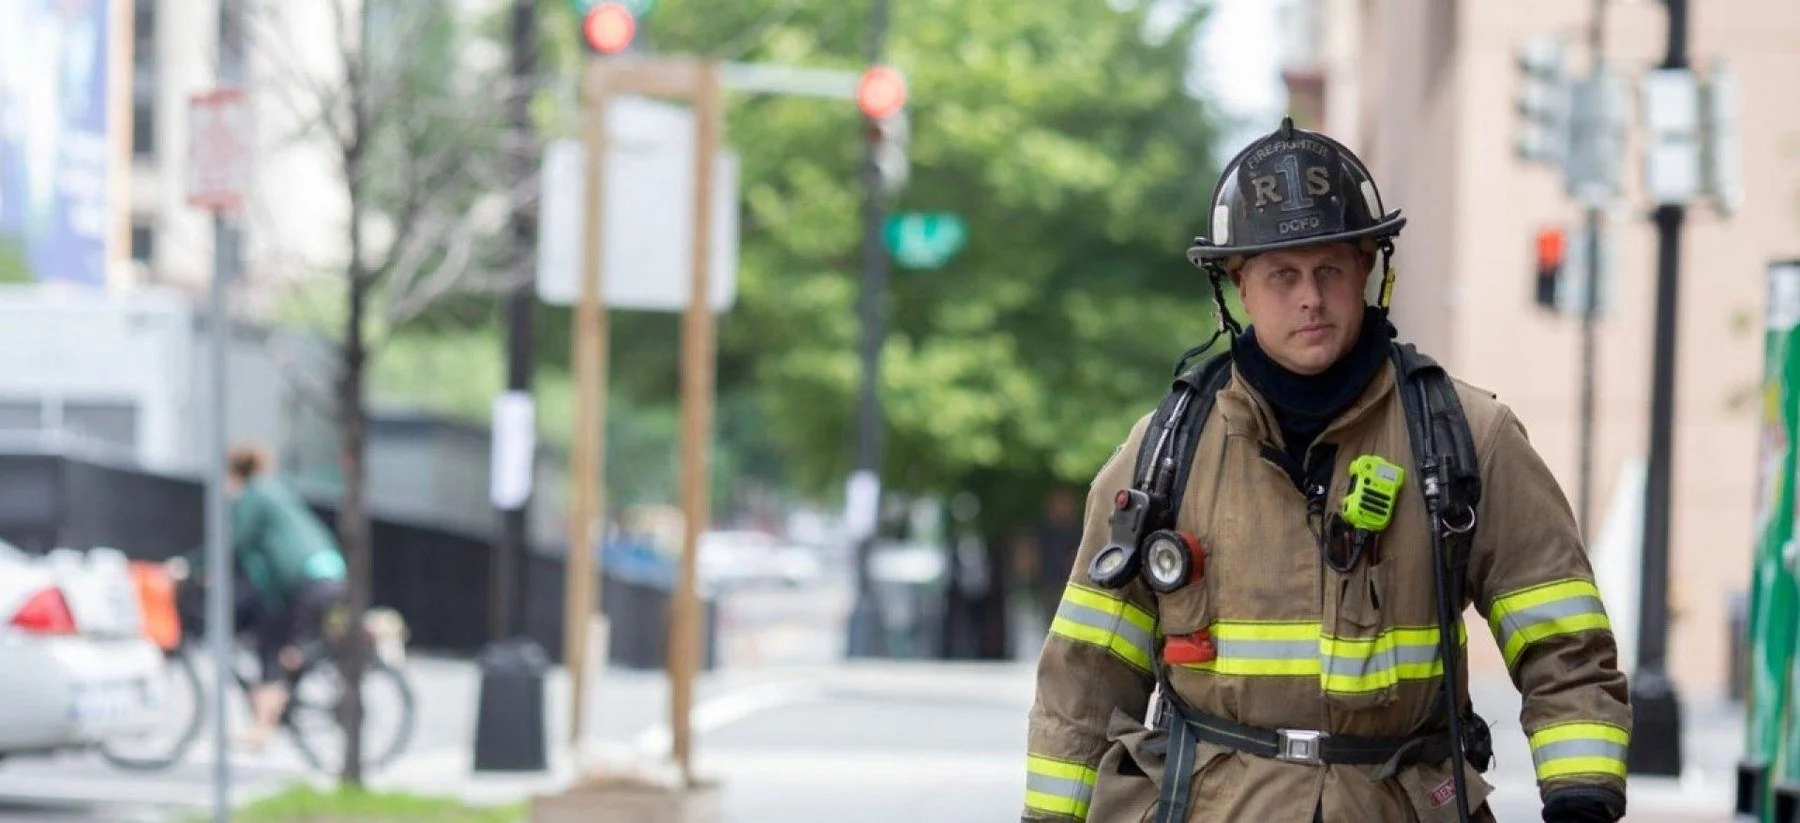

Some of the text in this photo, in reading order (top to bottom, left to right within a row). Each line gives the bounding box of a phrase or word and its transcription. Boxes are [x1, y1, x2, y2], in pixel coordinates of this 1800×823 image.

[1247, 139, 1330, 169] FIREFIGHTER
[1252, 154, 1331, 212] R 1 S
